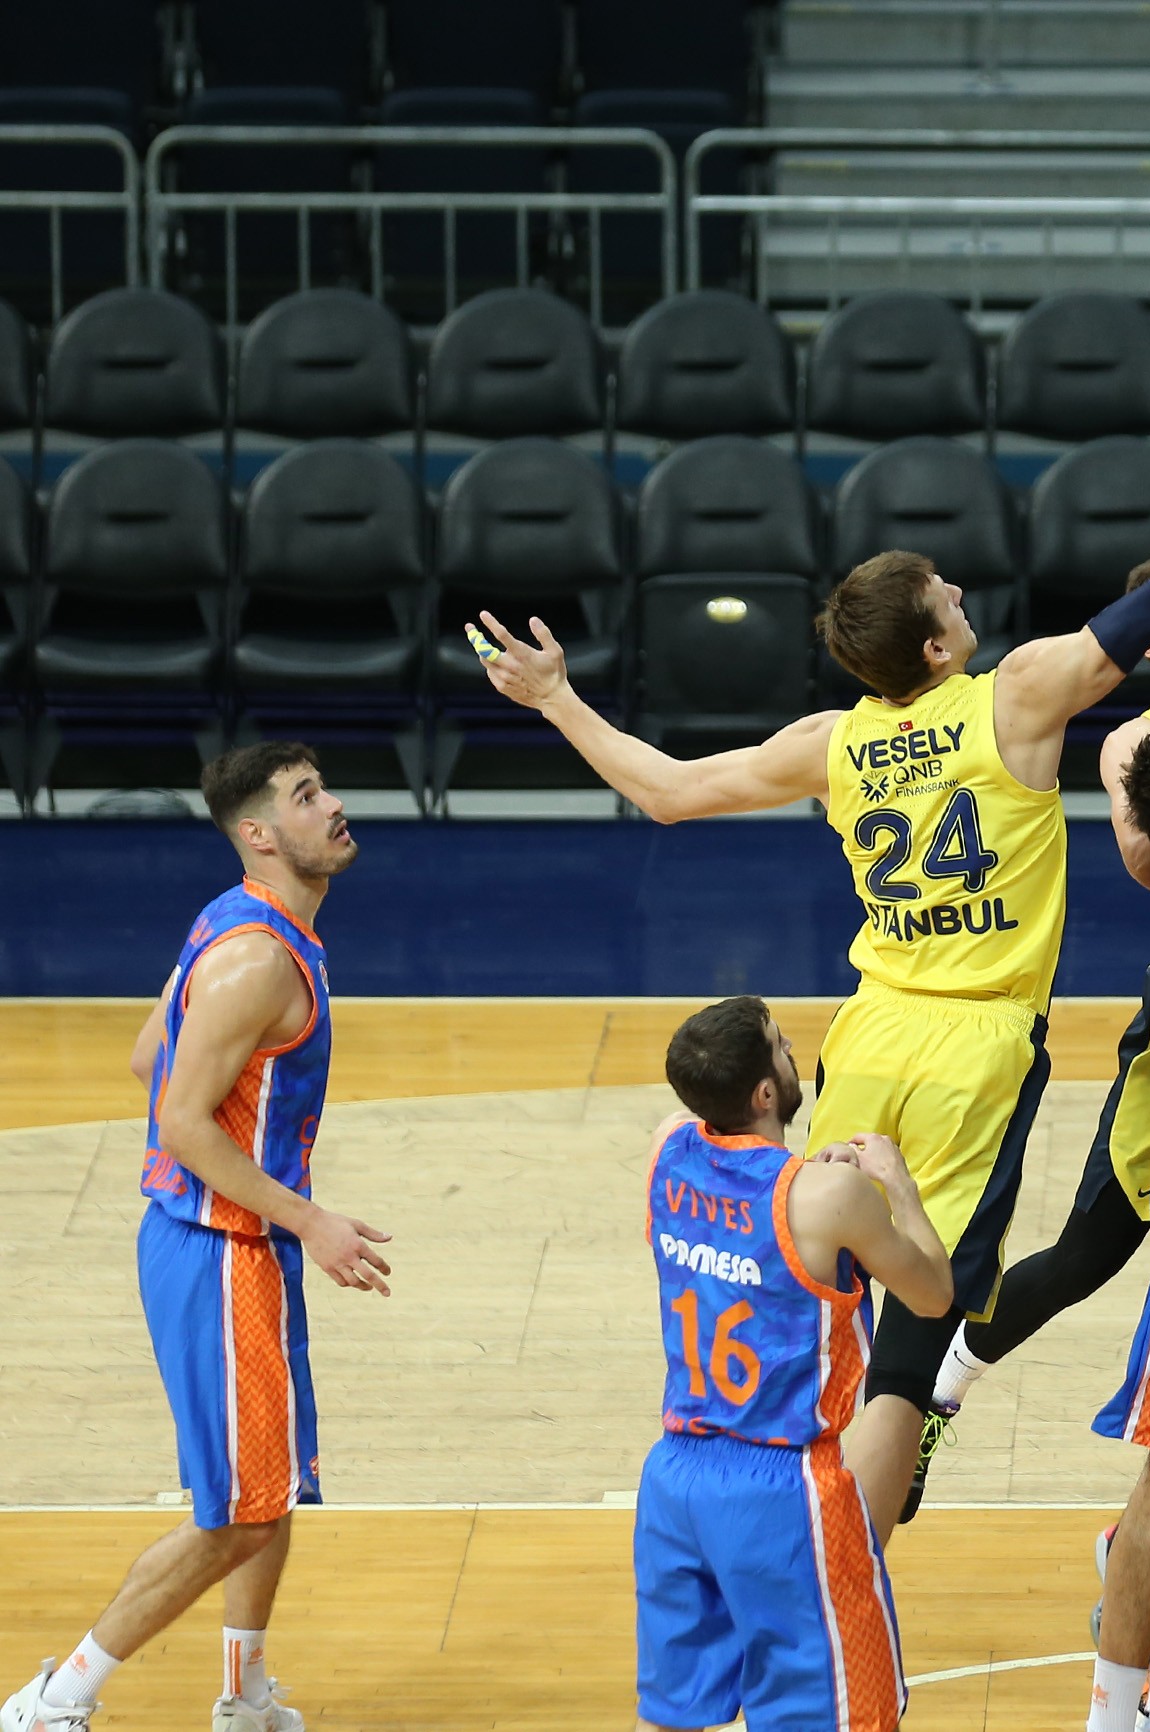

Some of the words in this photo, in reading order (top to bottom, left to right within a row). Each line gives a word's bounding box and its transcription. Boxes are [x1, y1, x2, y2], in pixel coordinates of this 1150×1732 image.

[847, 721, 964, 771] VESELY
[894, 759, 943, 784] QNB
[895, 778, 960, 797] FINANSBANK
[854, 787, 998, 902] 24
[867, 897, 1019, 942] STANBUL
[665, 1178, 754, 1234] VIVES
[659, 1233, 762, 1286] PAMESA
[671, 1288, 761, 1406] 16
